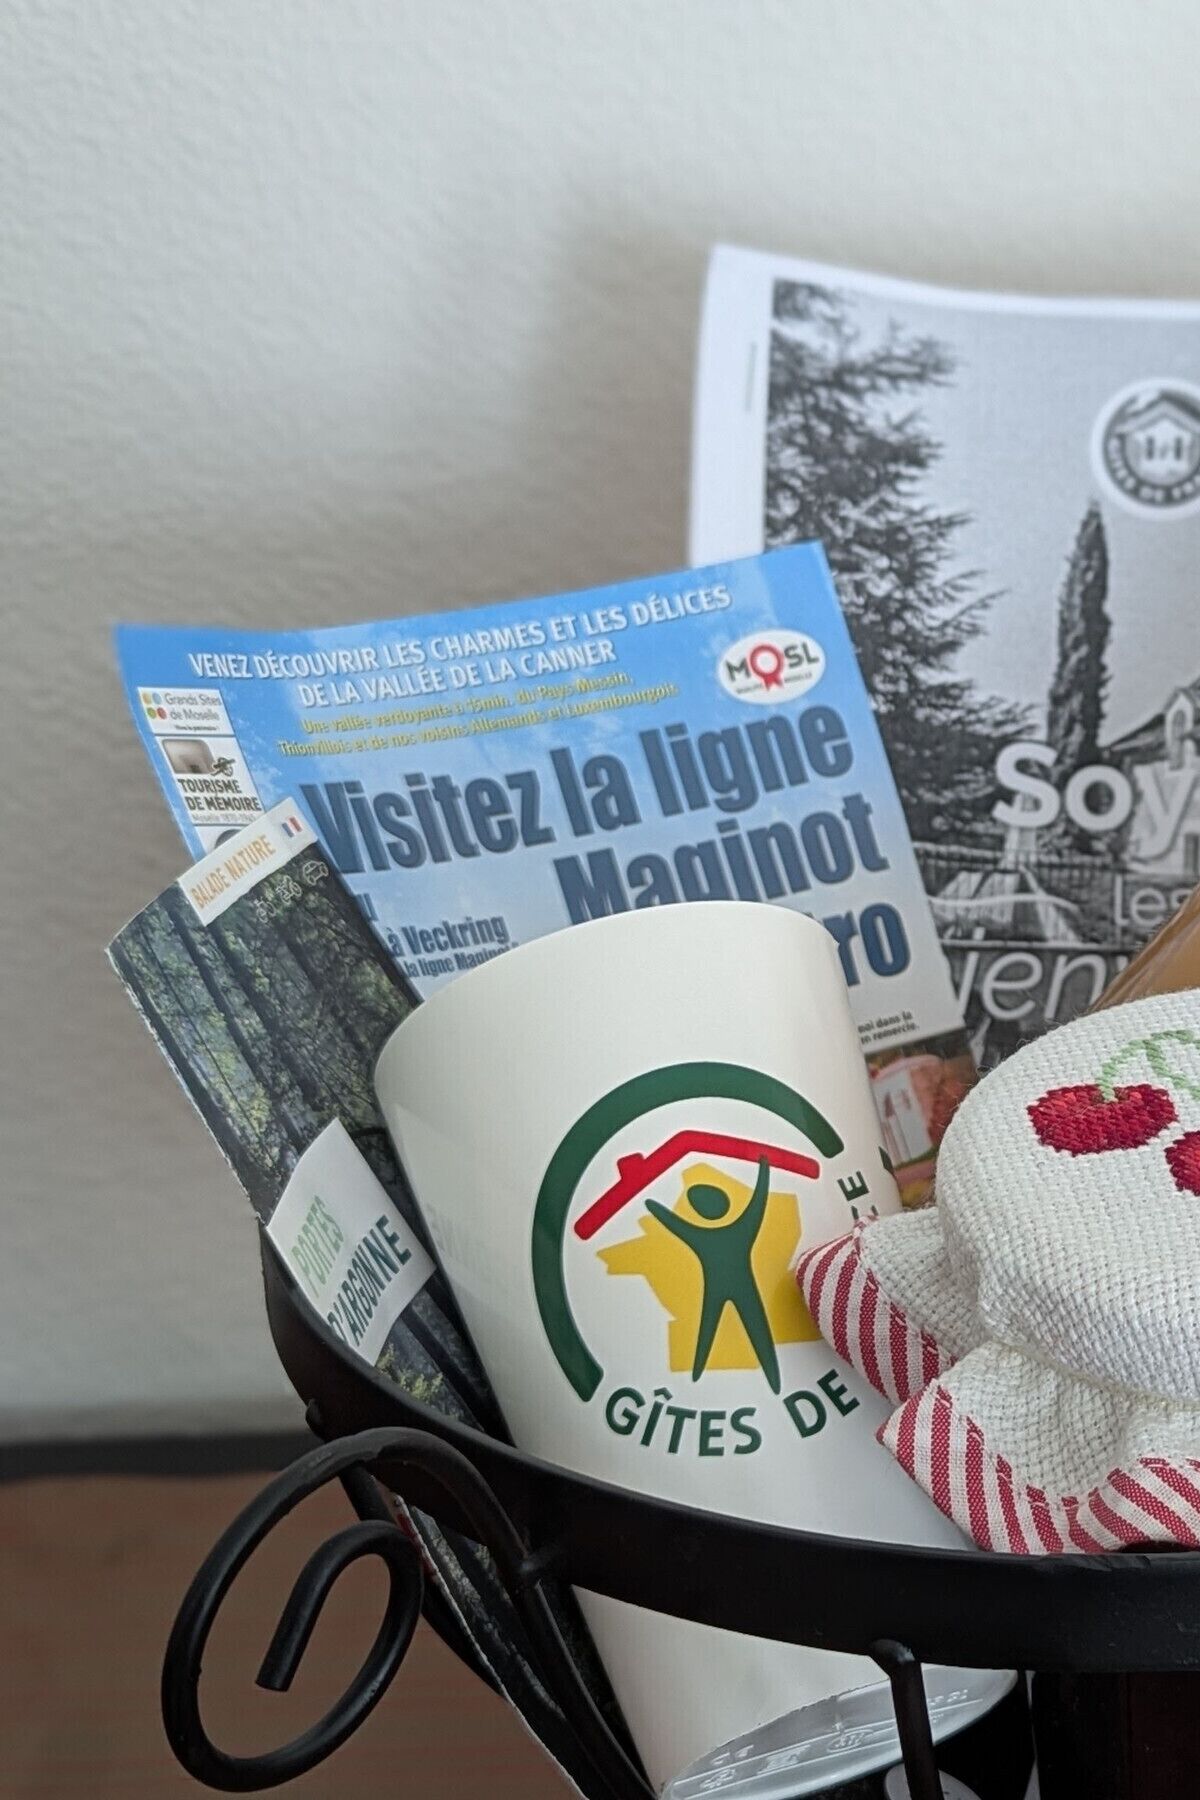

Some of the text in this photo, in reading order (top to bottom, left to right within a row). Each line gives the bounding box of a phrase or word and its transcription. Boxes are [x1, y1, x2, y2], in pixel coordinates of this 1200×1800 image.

[189, 585, 731, 679] VENEZ DÉCOUVRIR LES CHARMES ET LES DÉLICES
[299, 640, 617, 708] DE LA VALLÉE DE LA CANNER
[170, 707, 182, 720] de
[302, 719, 329, 734] Une
[371, 735, 388, 750] de
[391, 733, 416, 747] nos
[177, 778, 242, 794] TOURISME
[185, 796, 204, 811] DE
[299, 705, 854, 874] Visitez la ligne
[190, 835, 277, 909] BALADE NATURE
[386, 915, 511, 958] à Veckring
[419, 954, 455, 978] ligne
[291, 1194, 344, 1298] PORTES
[605, 1368, 861, 1458] GÎTES DE
